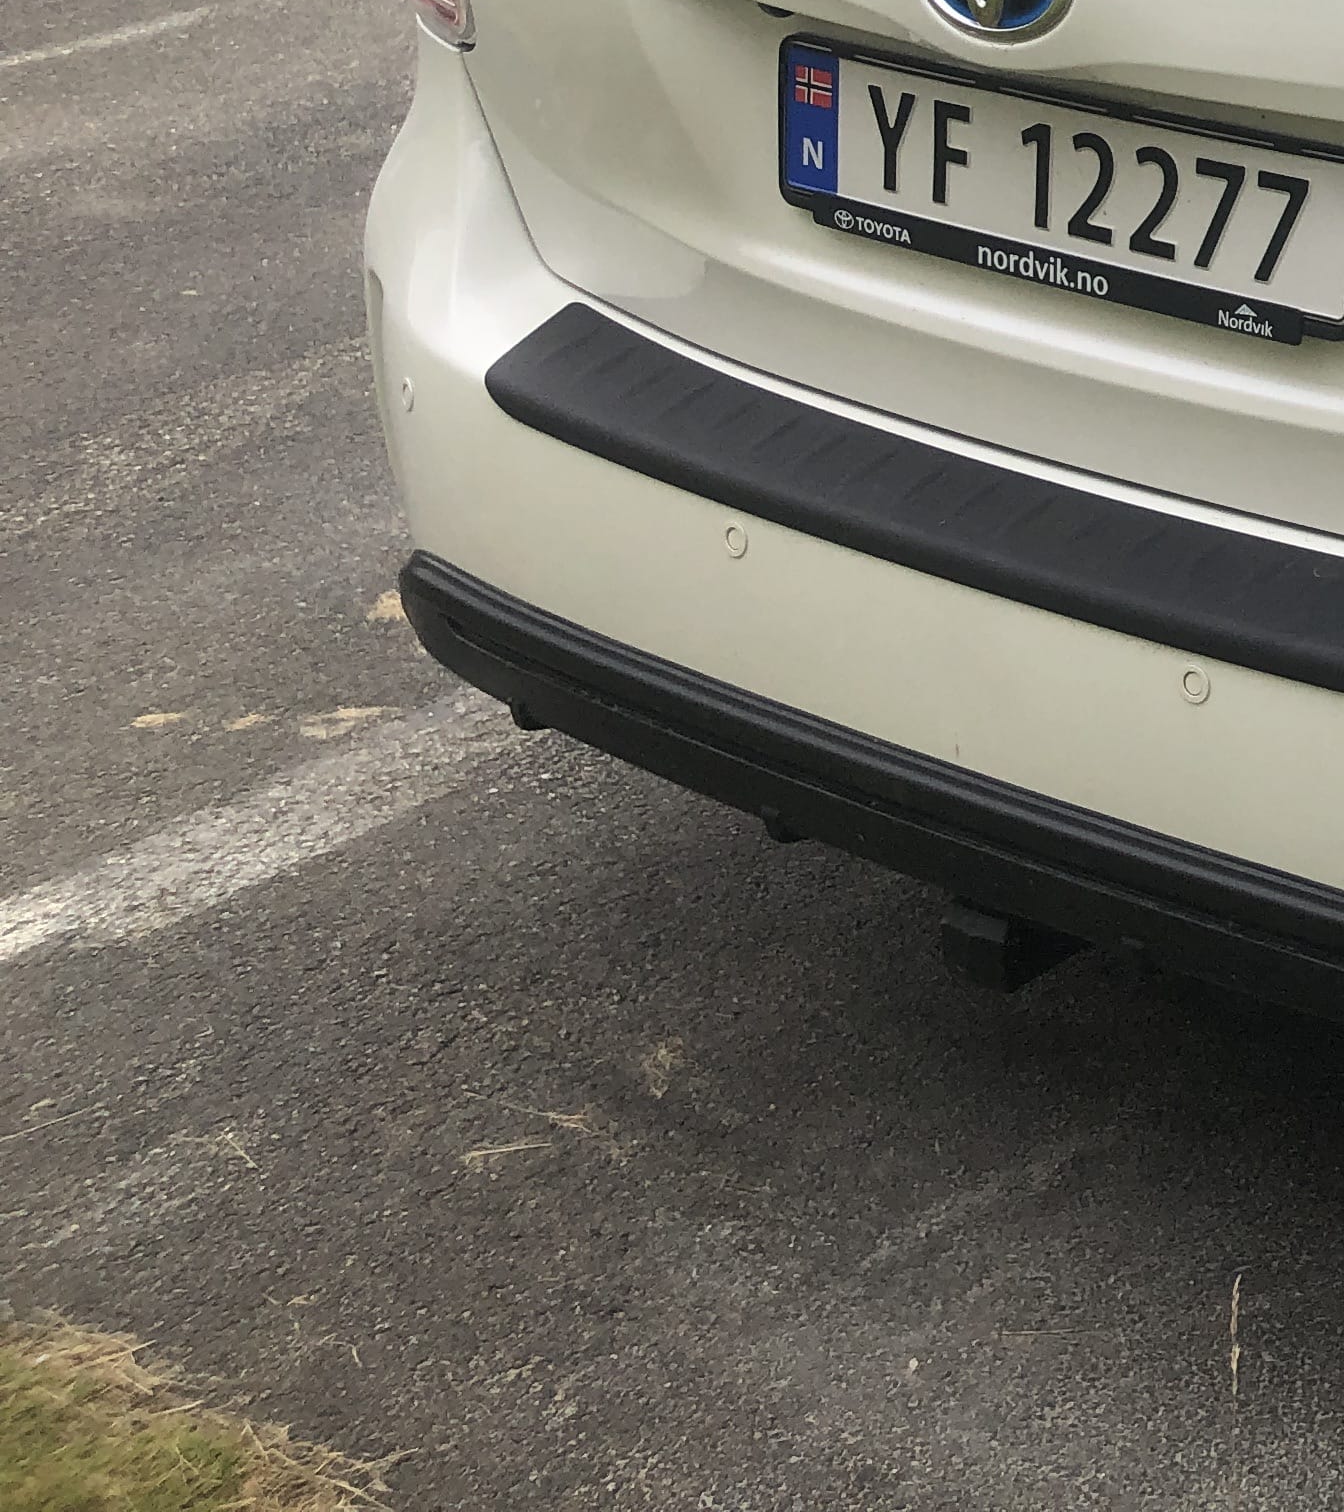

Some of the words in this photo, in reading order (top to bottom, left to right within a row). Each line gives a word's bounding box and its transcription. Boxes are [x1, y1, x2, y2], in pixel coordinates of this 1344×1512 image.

[802, 137, 824, 170] N
[868, 84, 972, 205] YF
[1021, 122, 1311, 283] 12277
[855, 216, 911, 244] TOYOTA
[978, 245, 1109, 296] nordvik.no
[1218, 309, 1273, 338] Nordvik
